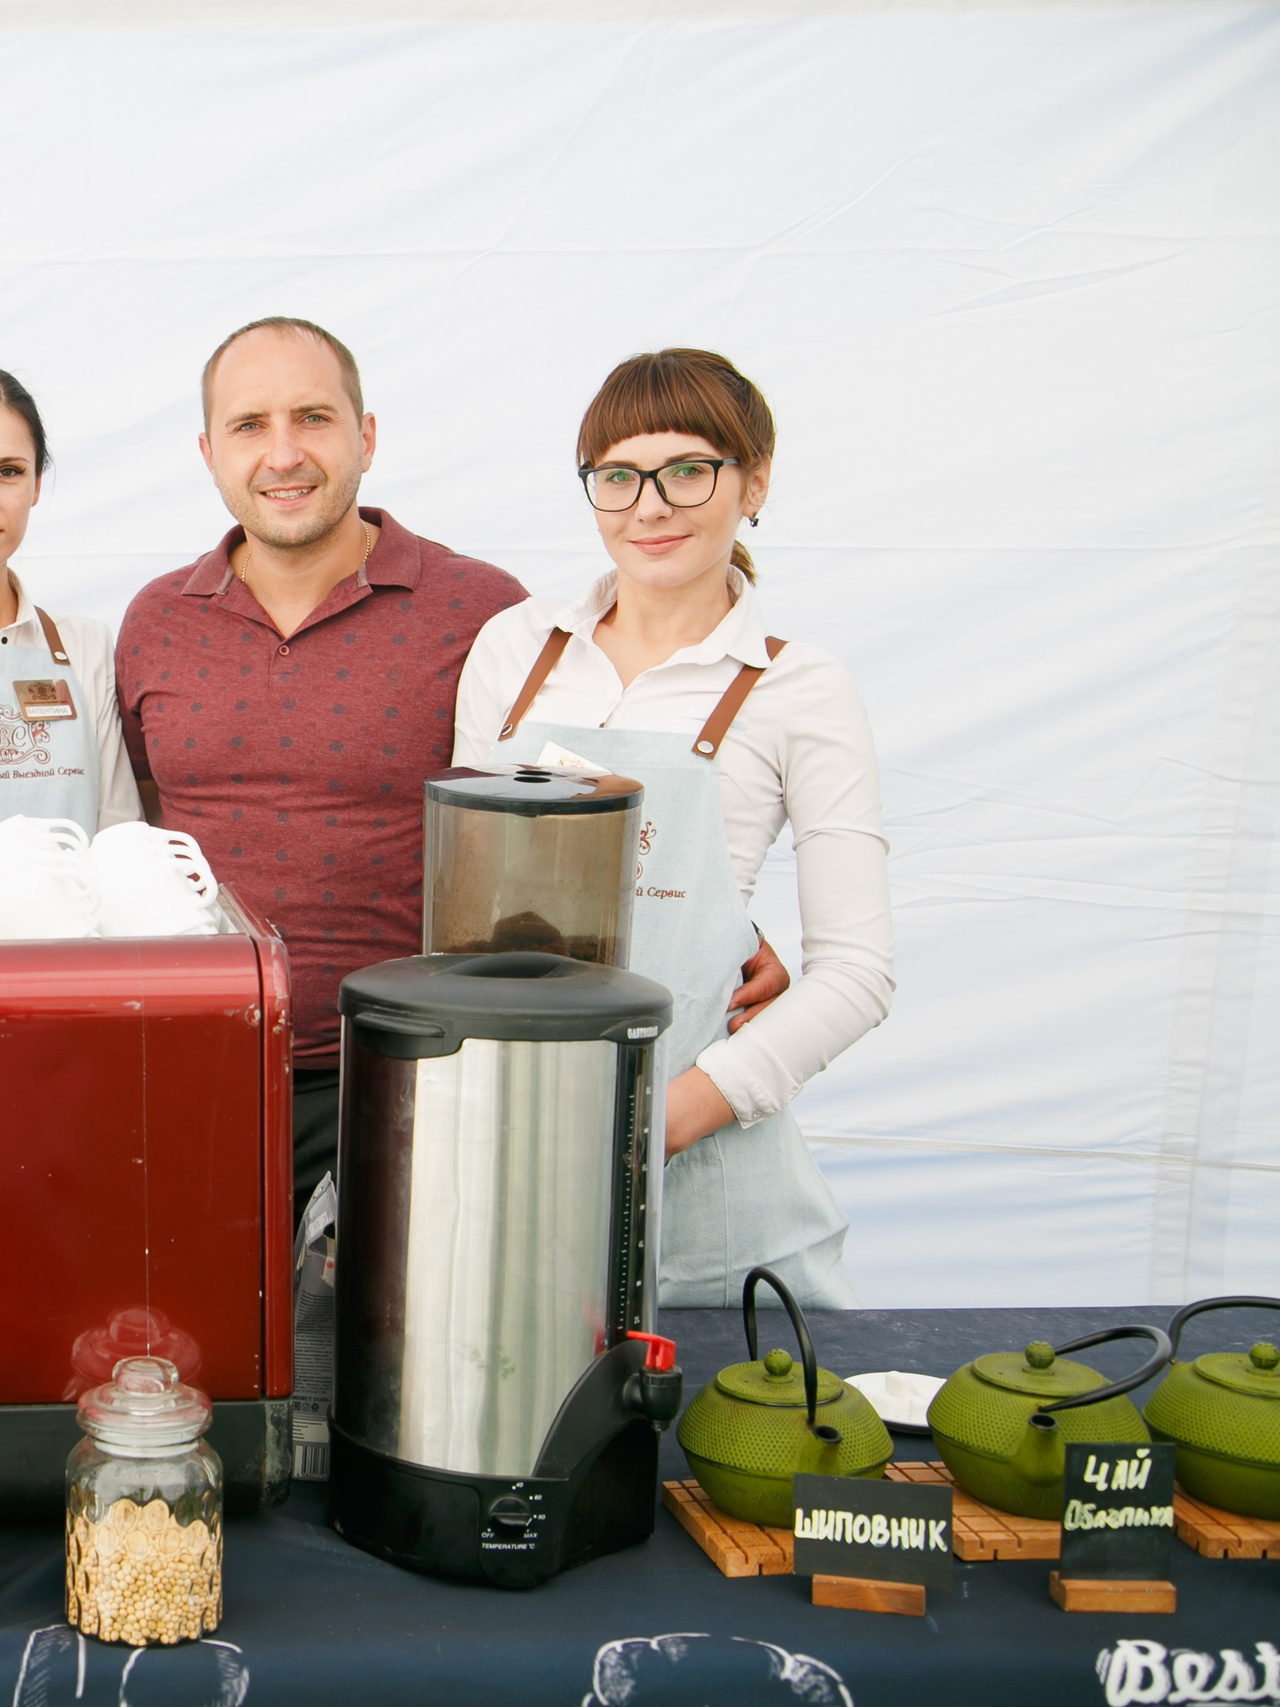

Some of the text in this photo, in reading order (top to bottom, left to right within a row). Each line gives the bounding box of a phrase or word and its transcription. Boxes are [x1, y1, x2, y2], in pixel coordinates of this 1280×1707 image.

[13, 768, 55, 780] Выездной
[57, 766, 85, 778] Сервис
[647, 886, 687, 899] Сервис
[1083, 1448, 1153, 1491] ЧАЙ
[793, 1508, 949, 1553] ШИПОВНИК
[481, 1542, 527, 1550] TEMPERATURE
